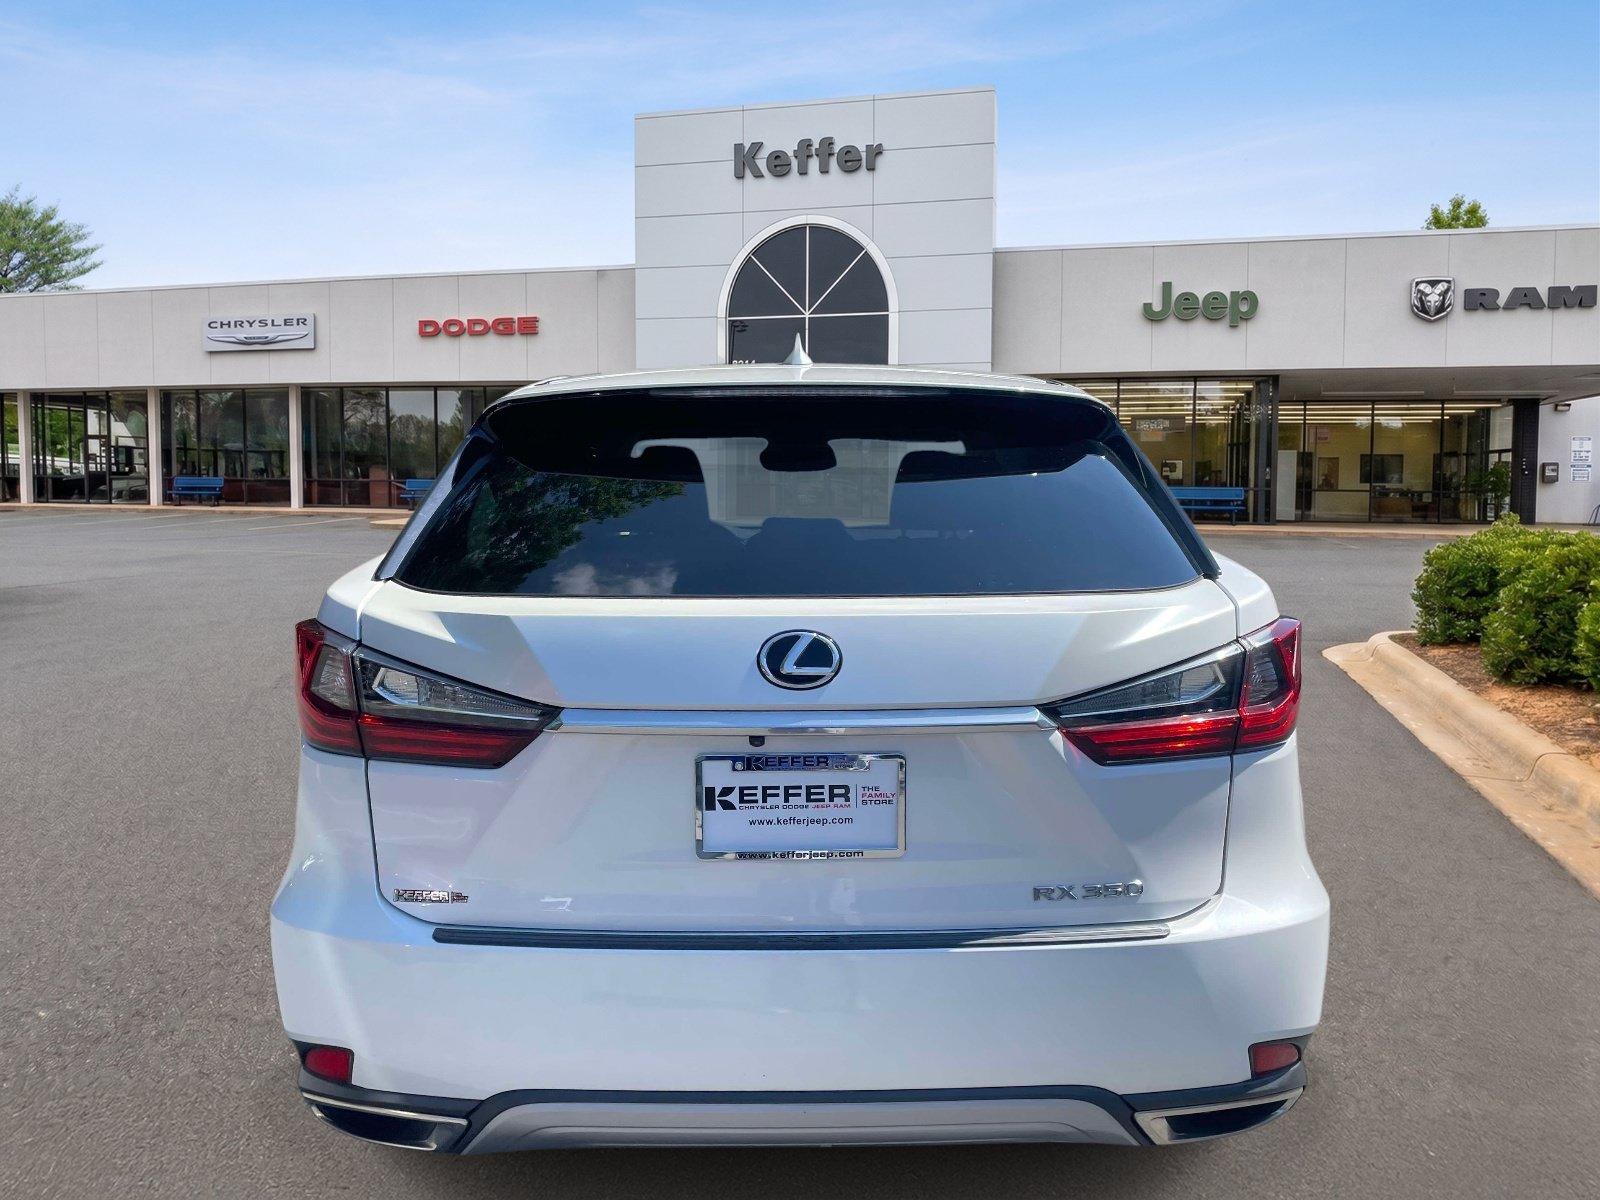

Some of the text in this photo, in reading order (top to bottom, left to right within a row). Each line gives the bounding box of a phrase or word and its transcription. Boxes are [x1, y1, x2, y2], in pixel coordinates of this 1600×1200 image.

[735, 137, 881, 178] Keffer
[1142, 281, 1260, 328] Jeep
[1464, 285, 1598, 311] RAM
[207, 317, 308, 329] CHRYSLER
[418, 316, 539, 337] DODGE
[745, 755, 829, 771] KEFFER
[704, 784, 851, 811] KEFFER
[748, 816, 854, 827] www.kefferjeep.com
[737, 850, 864, 860] www.kefferjeep.com
[393, 889, 449, 902] KEFFER
[1033, 880, 1143, 902] RX 350
